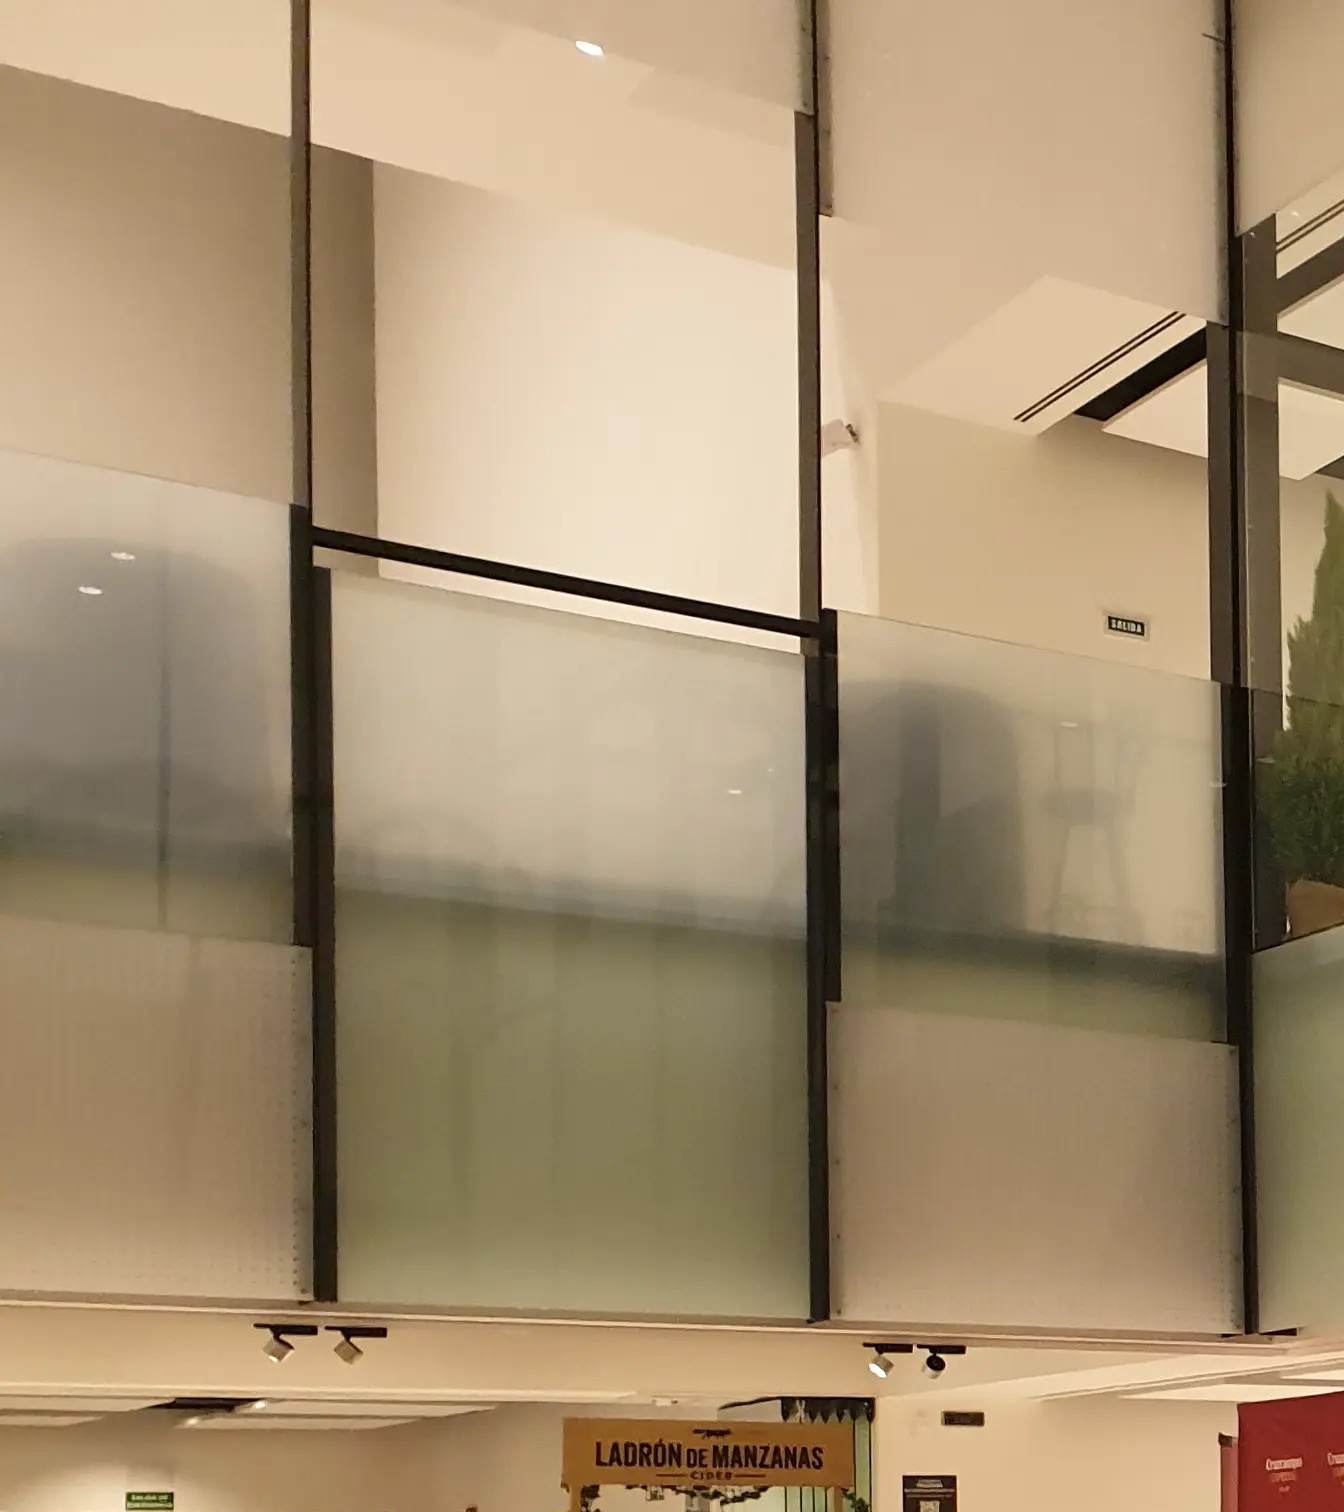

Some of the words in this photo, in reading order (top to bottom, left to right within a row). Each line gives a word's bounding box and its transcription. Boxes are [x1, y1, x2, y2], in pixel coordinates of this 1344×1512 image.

[1111, 619, 1142, 633] SALIDA
[595, 1438, 682, 1469] LADRÓN
[686, 1448, 709, 1469] DE
[712, 1444, 824, 1470] MANZANAS
